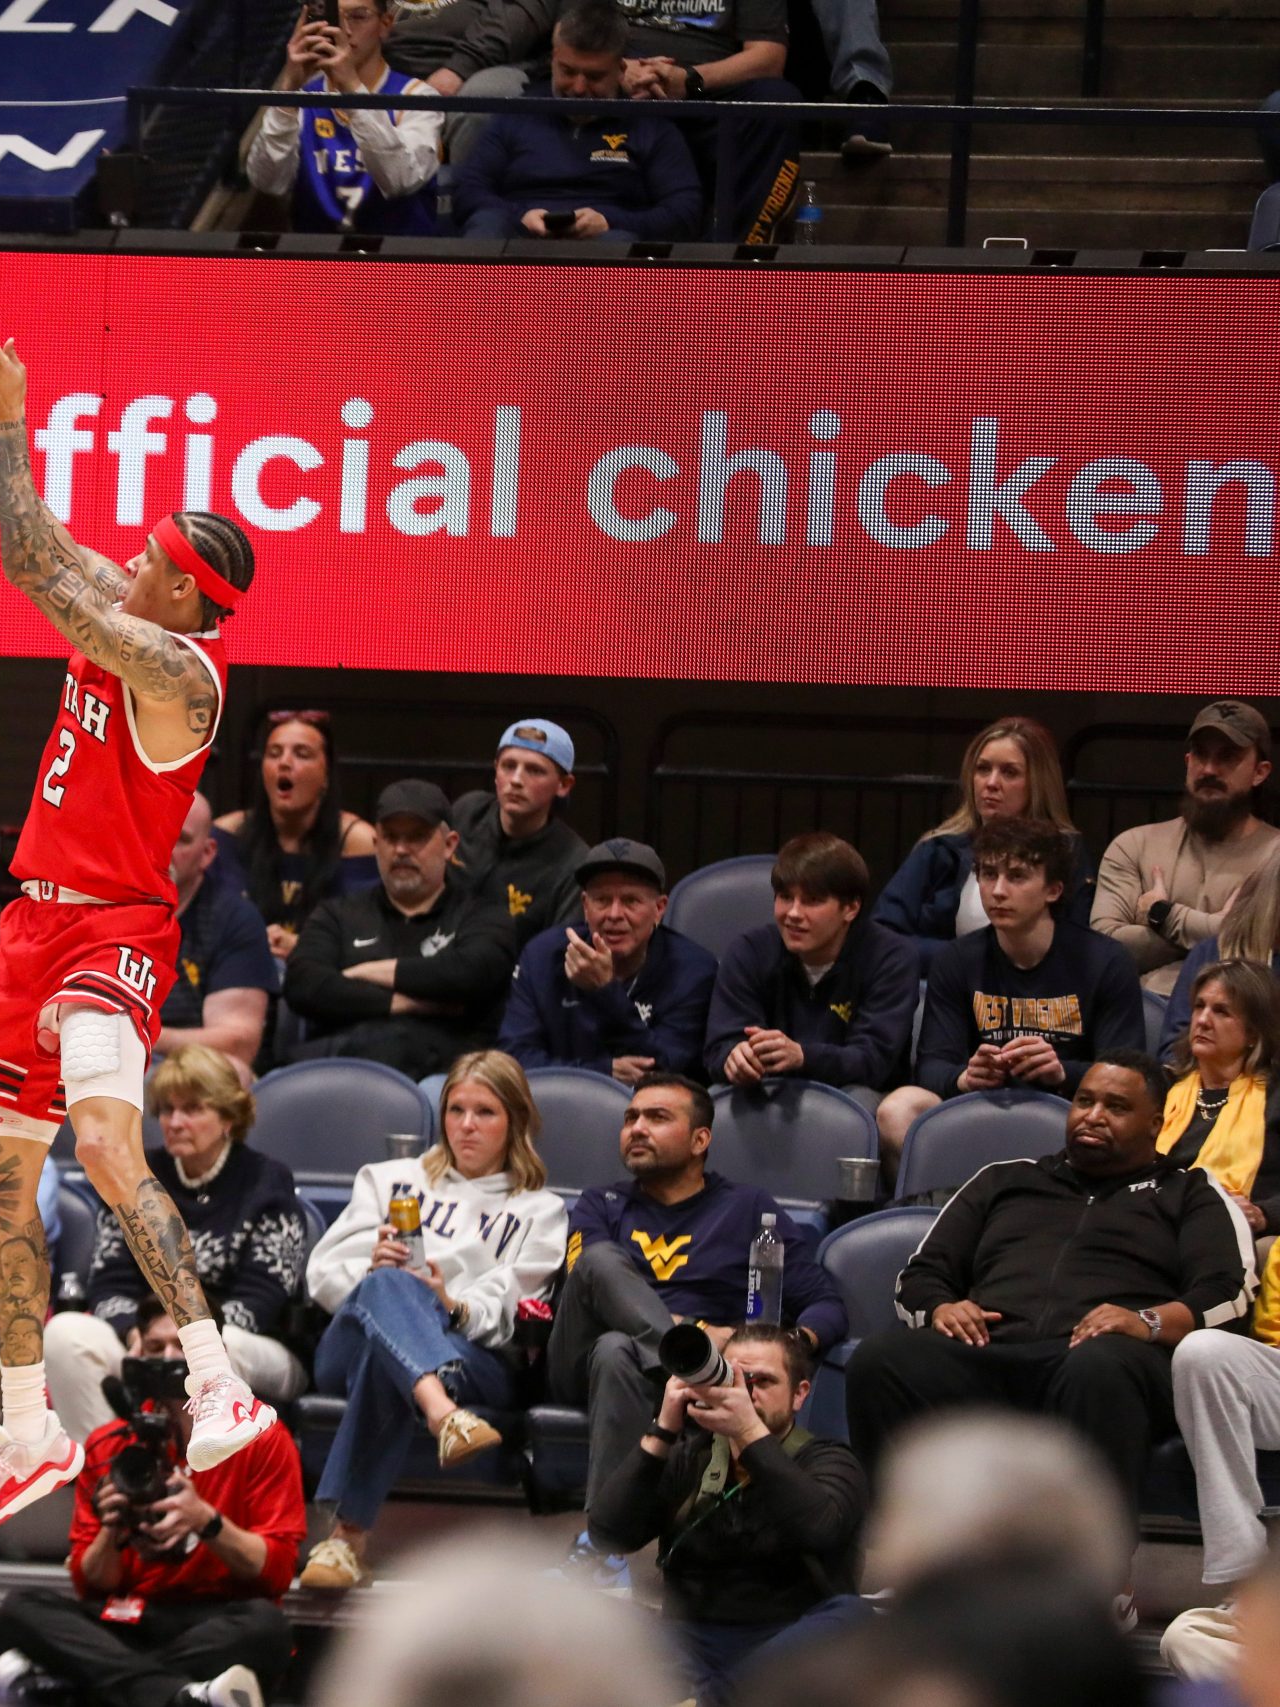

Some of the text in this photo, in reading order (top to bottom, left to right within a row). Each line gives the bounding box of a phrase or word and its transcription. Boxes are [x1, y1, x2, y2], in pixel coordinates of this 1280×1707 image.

[336, 186, 364, 226] 7
[587, 408, 1279, 558] chicken
[41, 726, 77, 810] 2
[1011, 994, 1083, 1036] VIRGINIA
